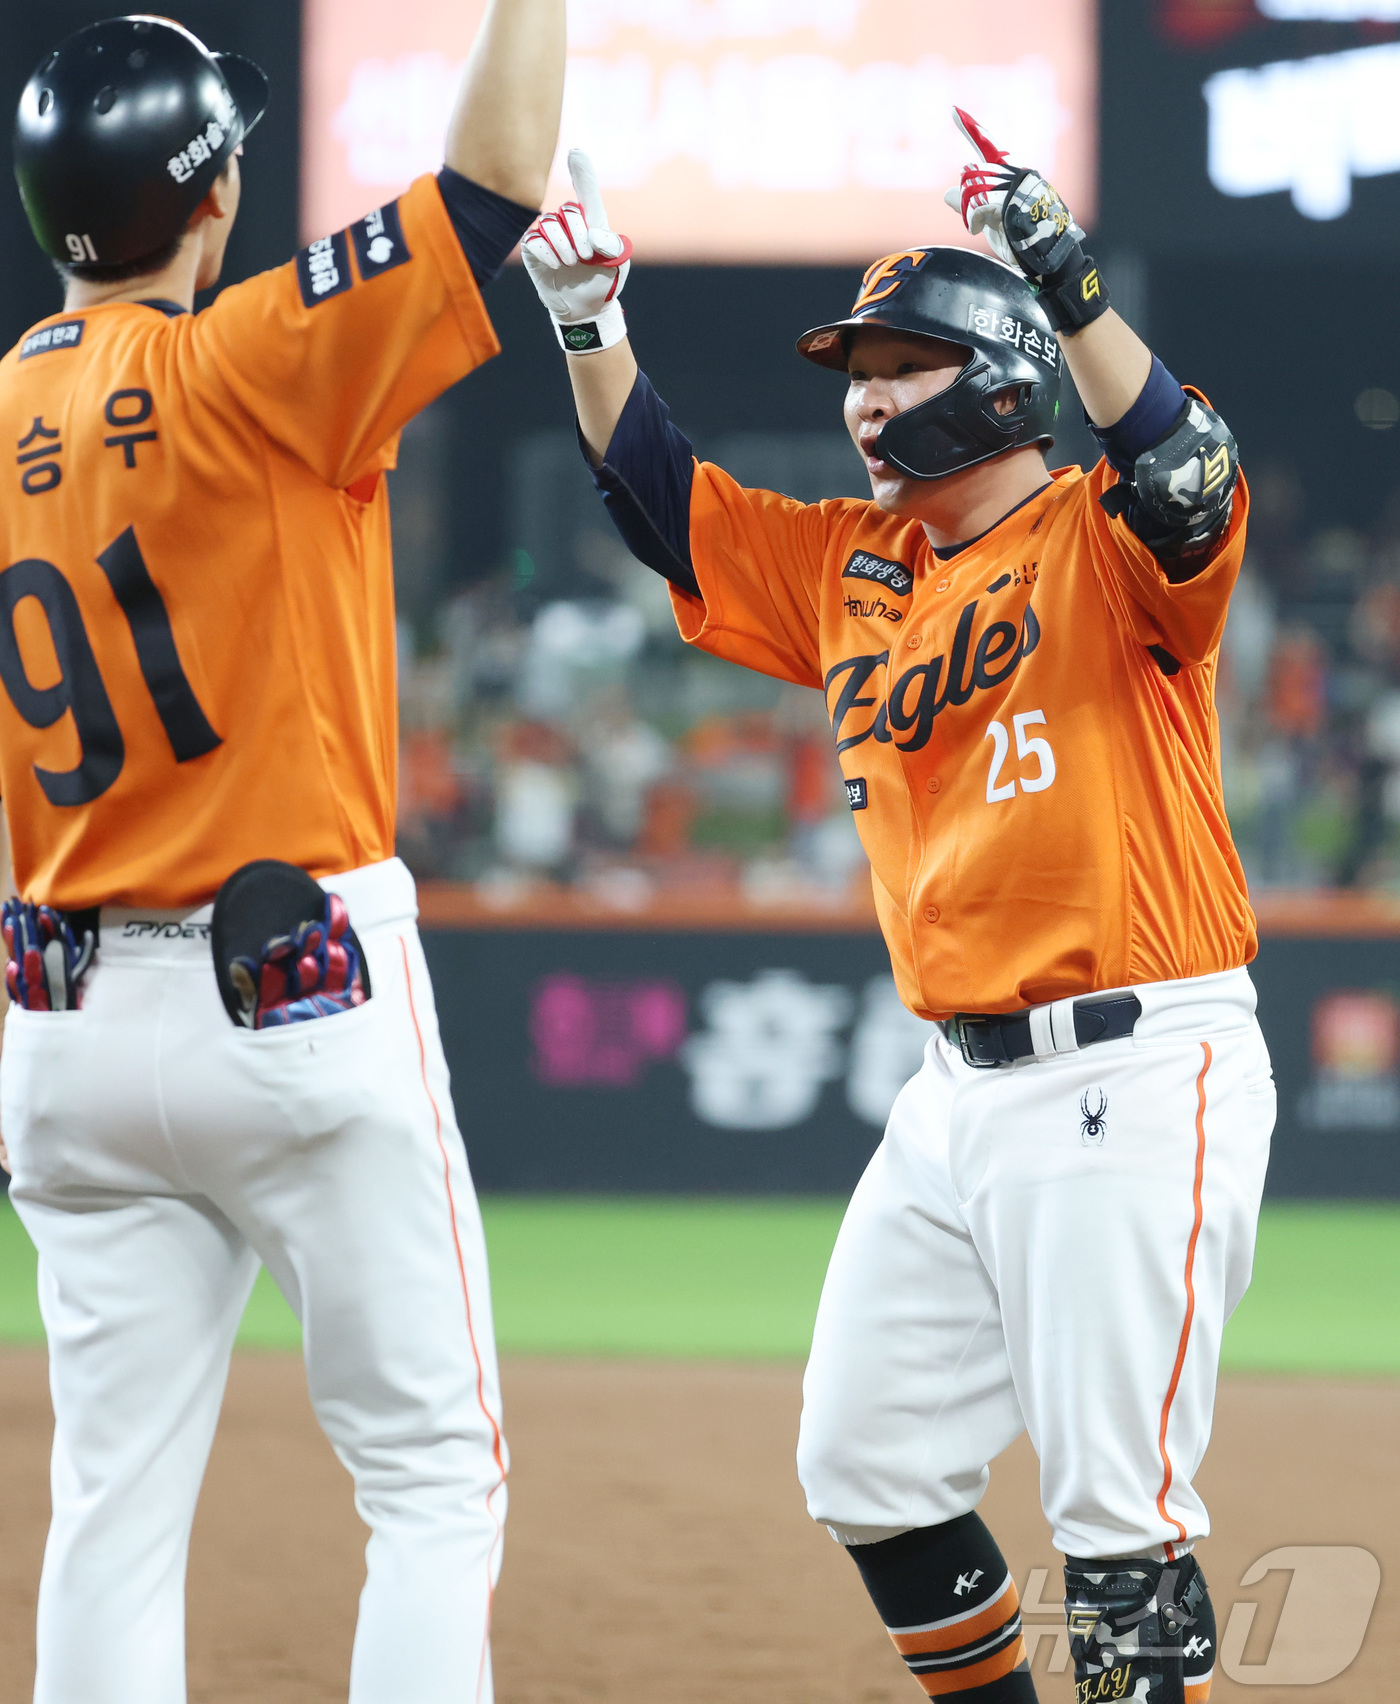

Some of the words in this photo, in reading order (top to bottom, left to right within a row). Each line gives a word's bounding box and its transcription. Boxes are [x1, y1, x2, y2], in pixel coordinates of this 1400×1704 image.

[166, 100, 234, 184] 한화솔
[65, 233, 99, 262] 91
[974, 308, 1057, 368] 한화손보
[848, 555, 911, 588] 한화생명
[0, 523, 225, 808] 91
[984, 709, 1057, 804] 25
